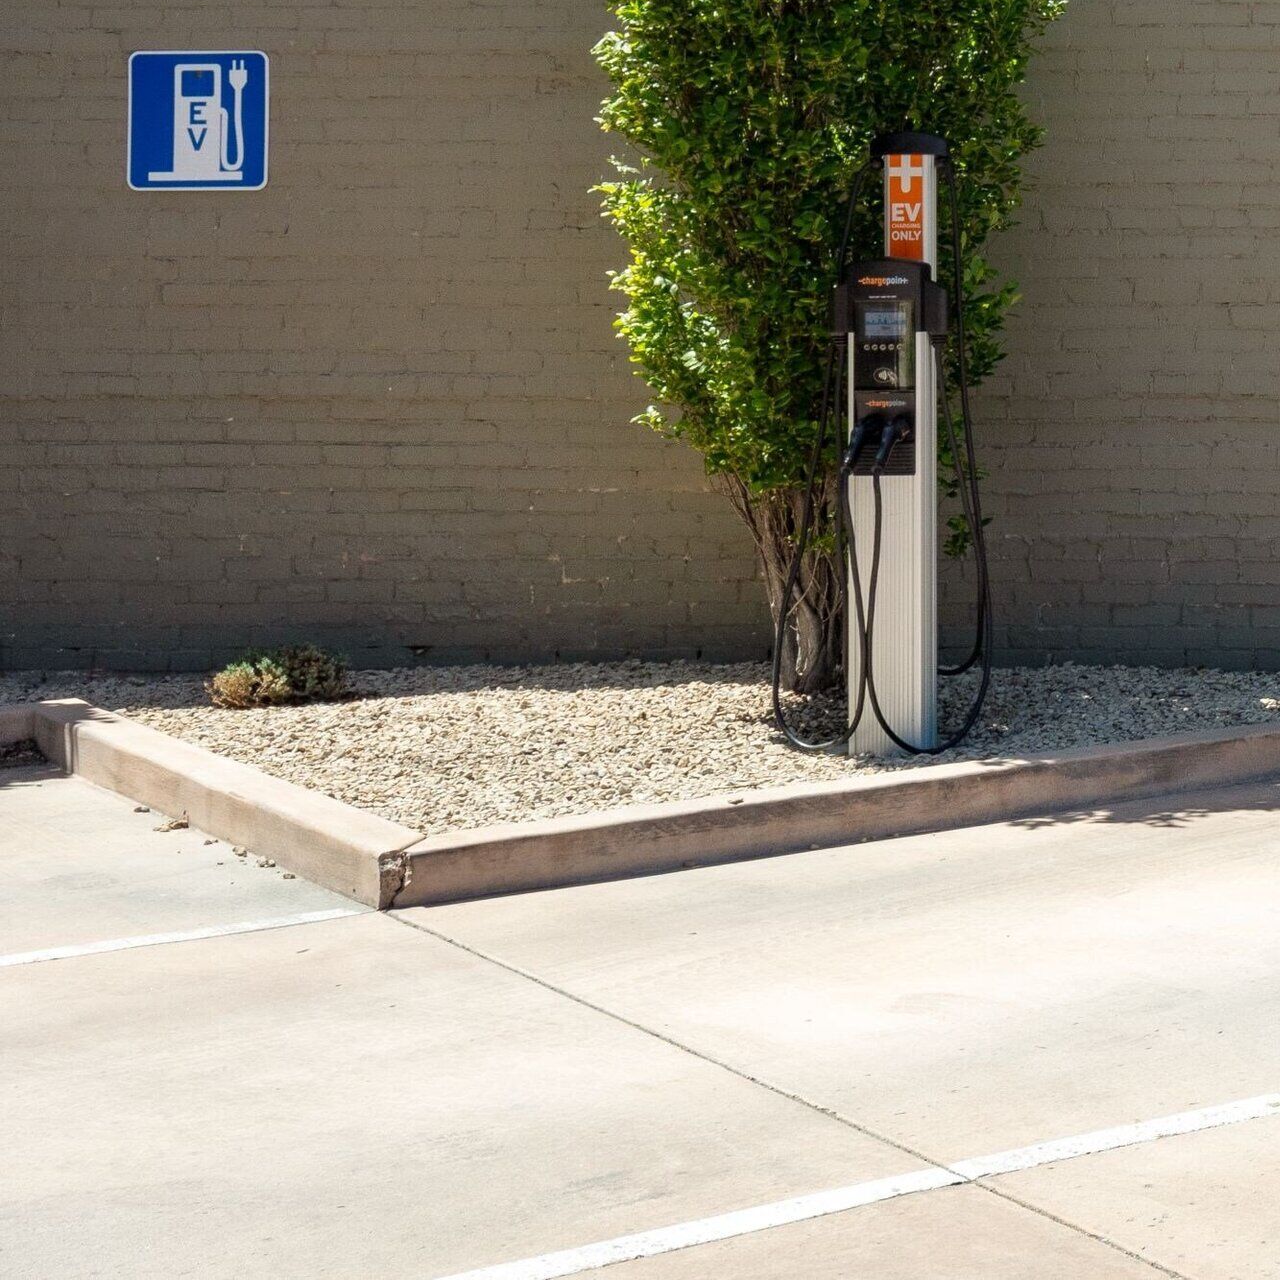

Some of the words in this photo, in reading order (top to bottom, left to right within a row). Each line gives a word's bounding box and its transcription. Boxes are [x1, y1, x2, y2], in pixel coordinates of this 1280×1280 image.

[187, 101, 208, 151] EV
[891, 202, 921, 222] EV
[891, 230, 922, 241] ONLY
